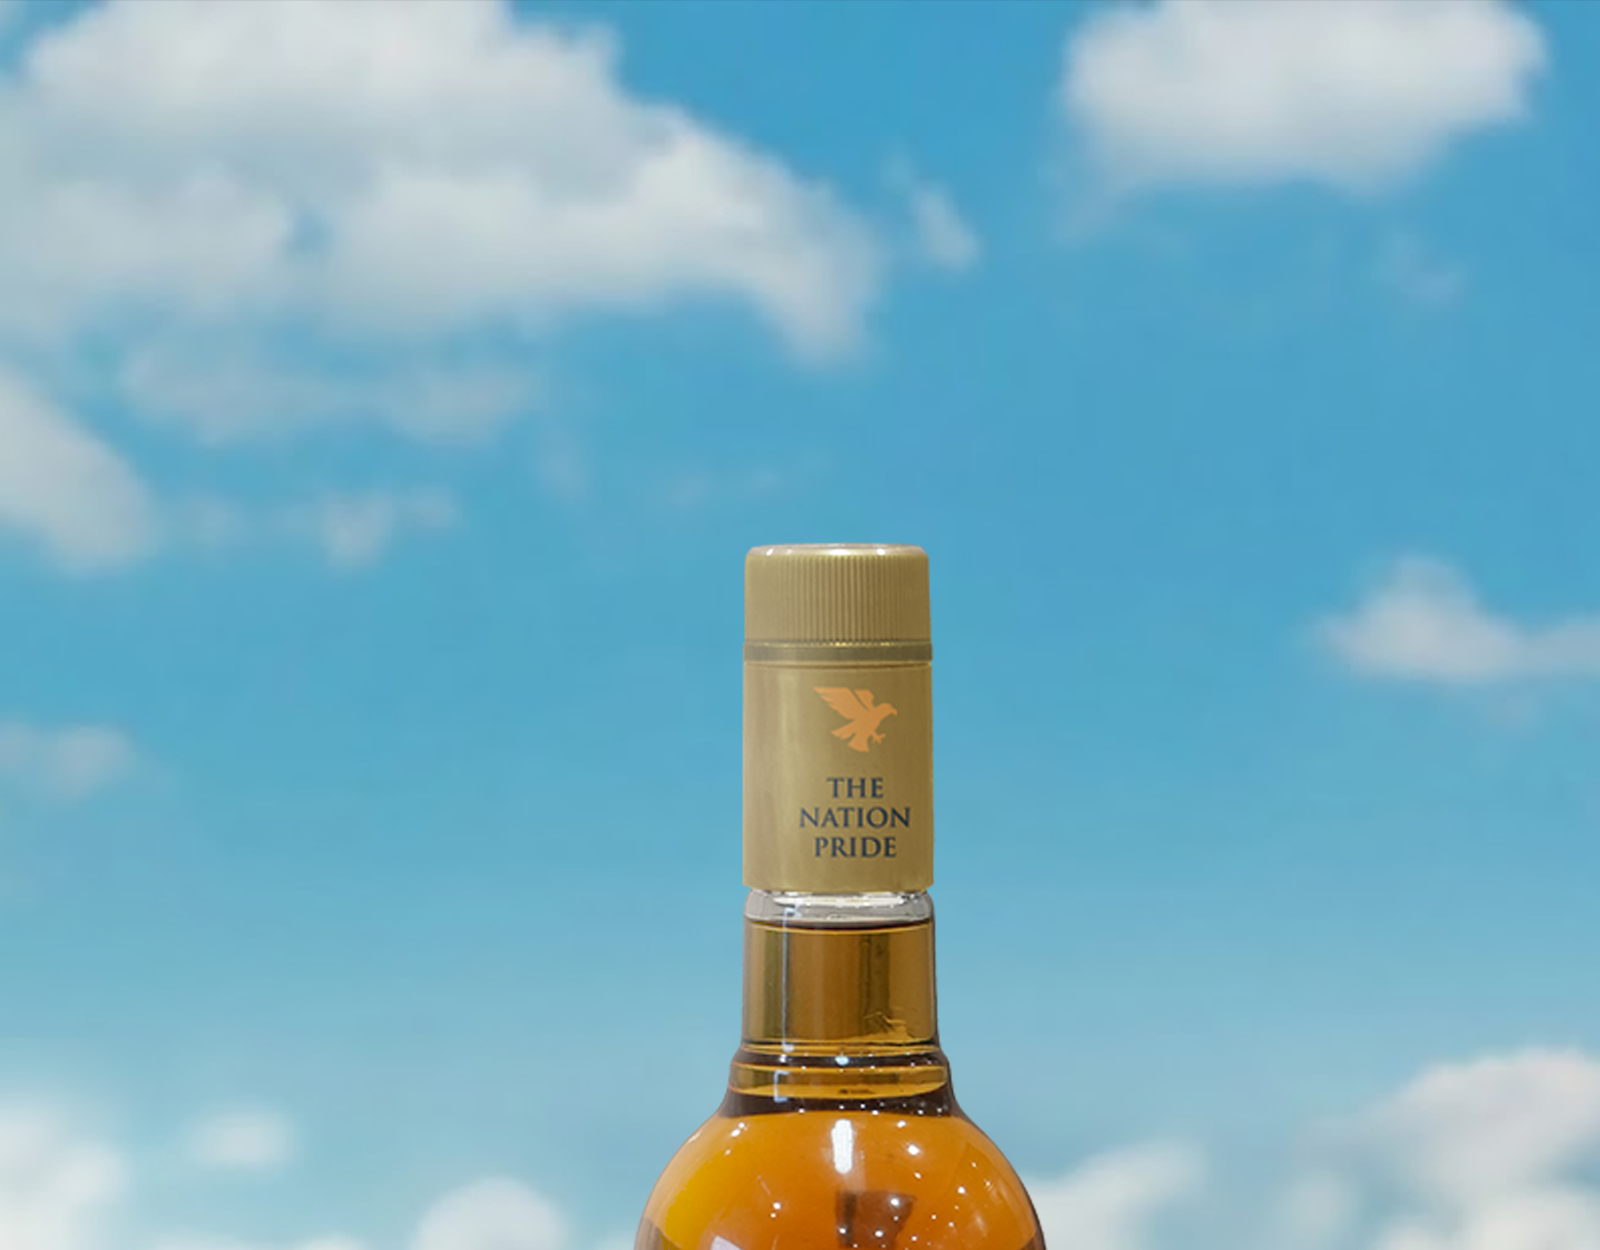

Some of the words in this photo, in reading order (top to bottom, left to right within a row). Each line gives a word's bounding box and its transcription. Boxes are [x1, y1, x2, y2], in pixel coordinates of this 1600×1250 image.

[826, 777, 883, 798] THE
[799, 806, 910, 828] NATION
[814, 836, 897, 858] PRIDE
